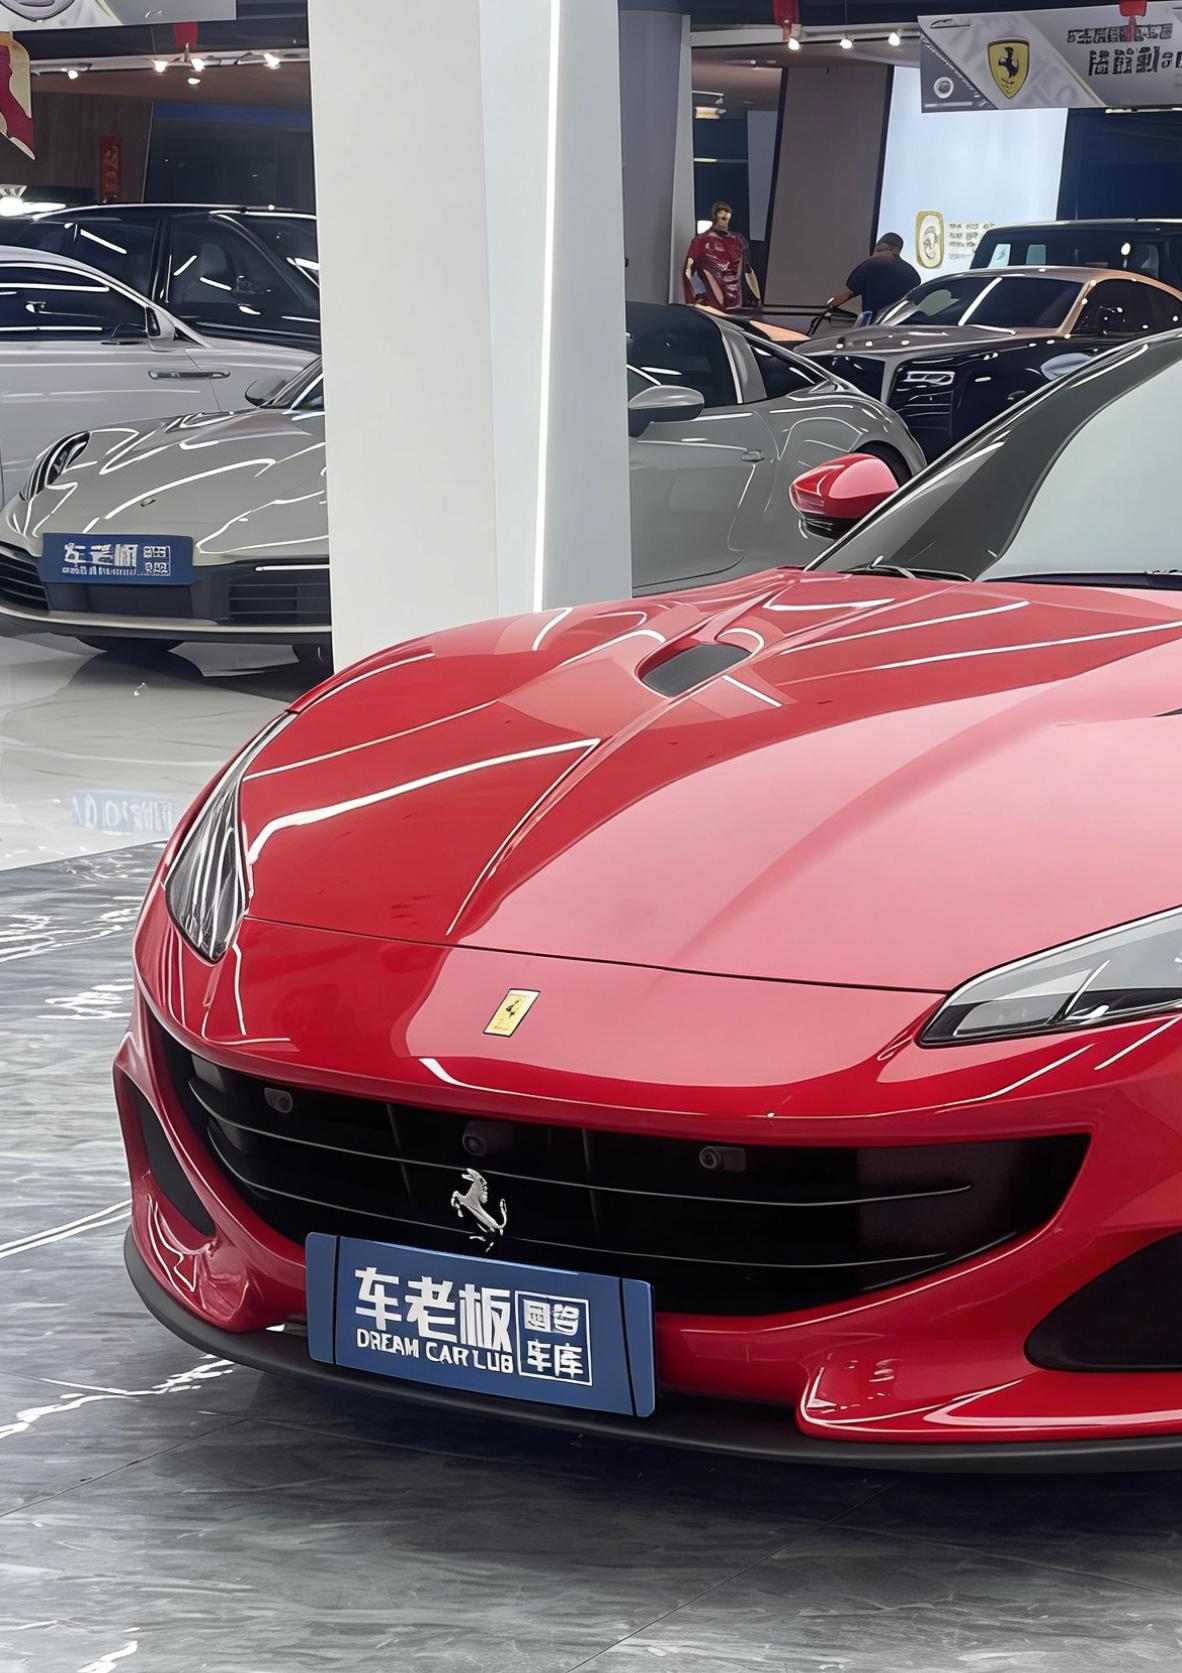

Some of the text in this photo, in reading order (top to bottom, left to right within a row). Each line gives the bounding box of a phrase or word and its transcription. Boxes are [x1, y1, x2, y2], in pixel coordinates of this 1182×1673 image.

[355, 1267, 512, 1353] 车老板
[356, 1328, 420, 1358] DREAM
[426, 1342, 468, 1367] CAR
[526, 1338, 584, 1379] 车库
